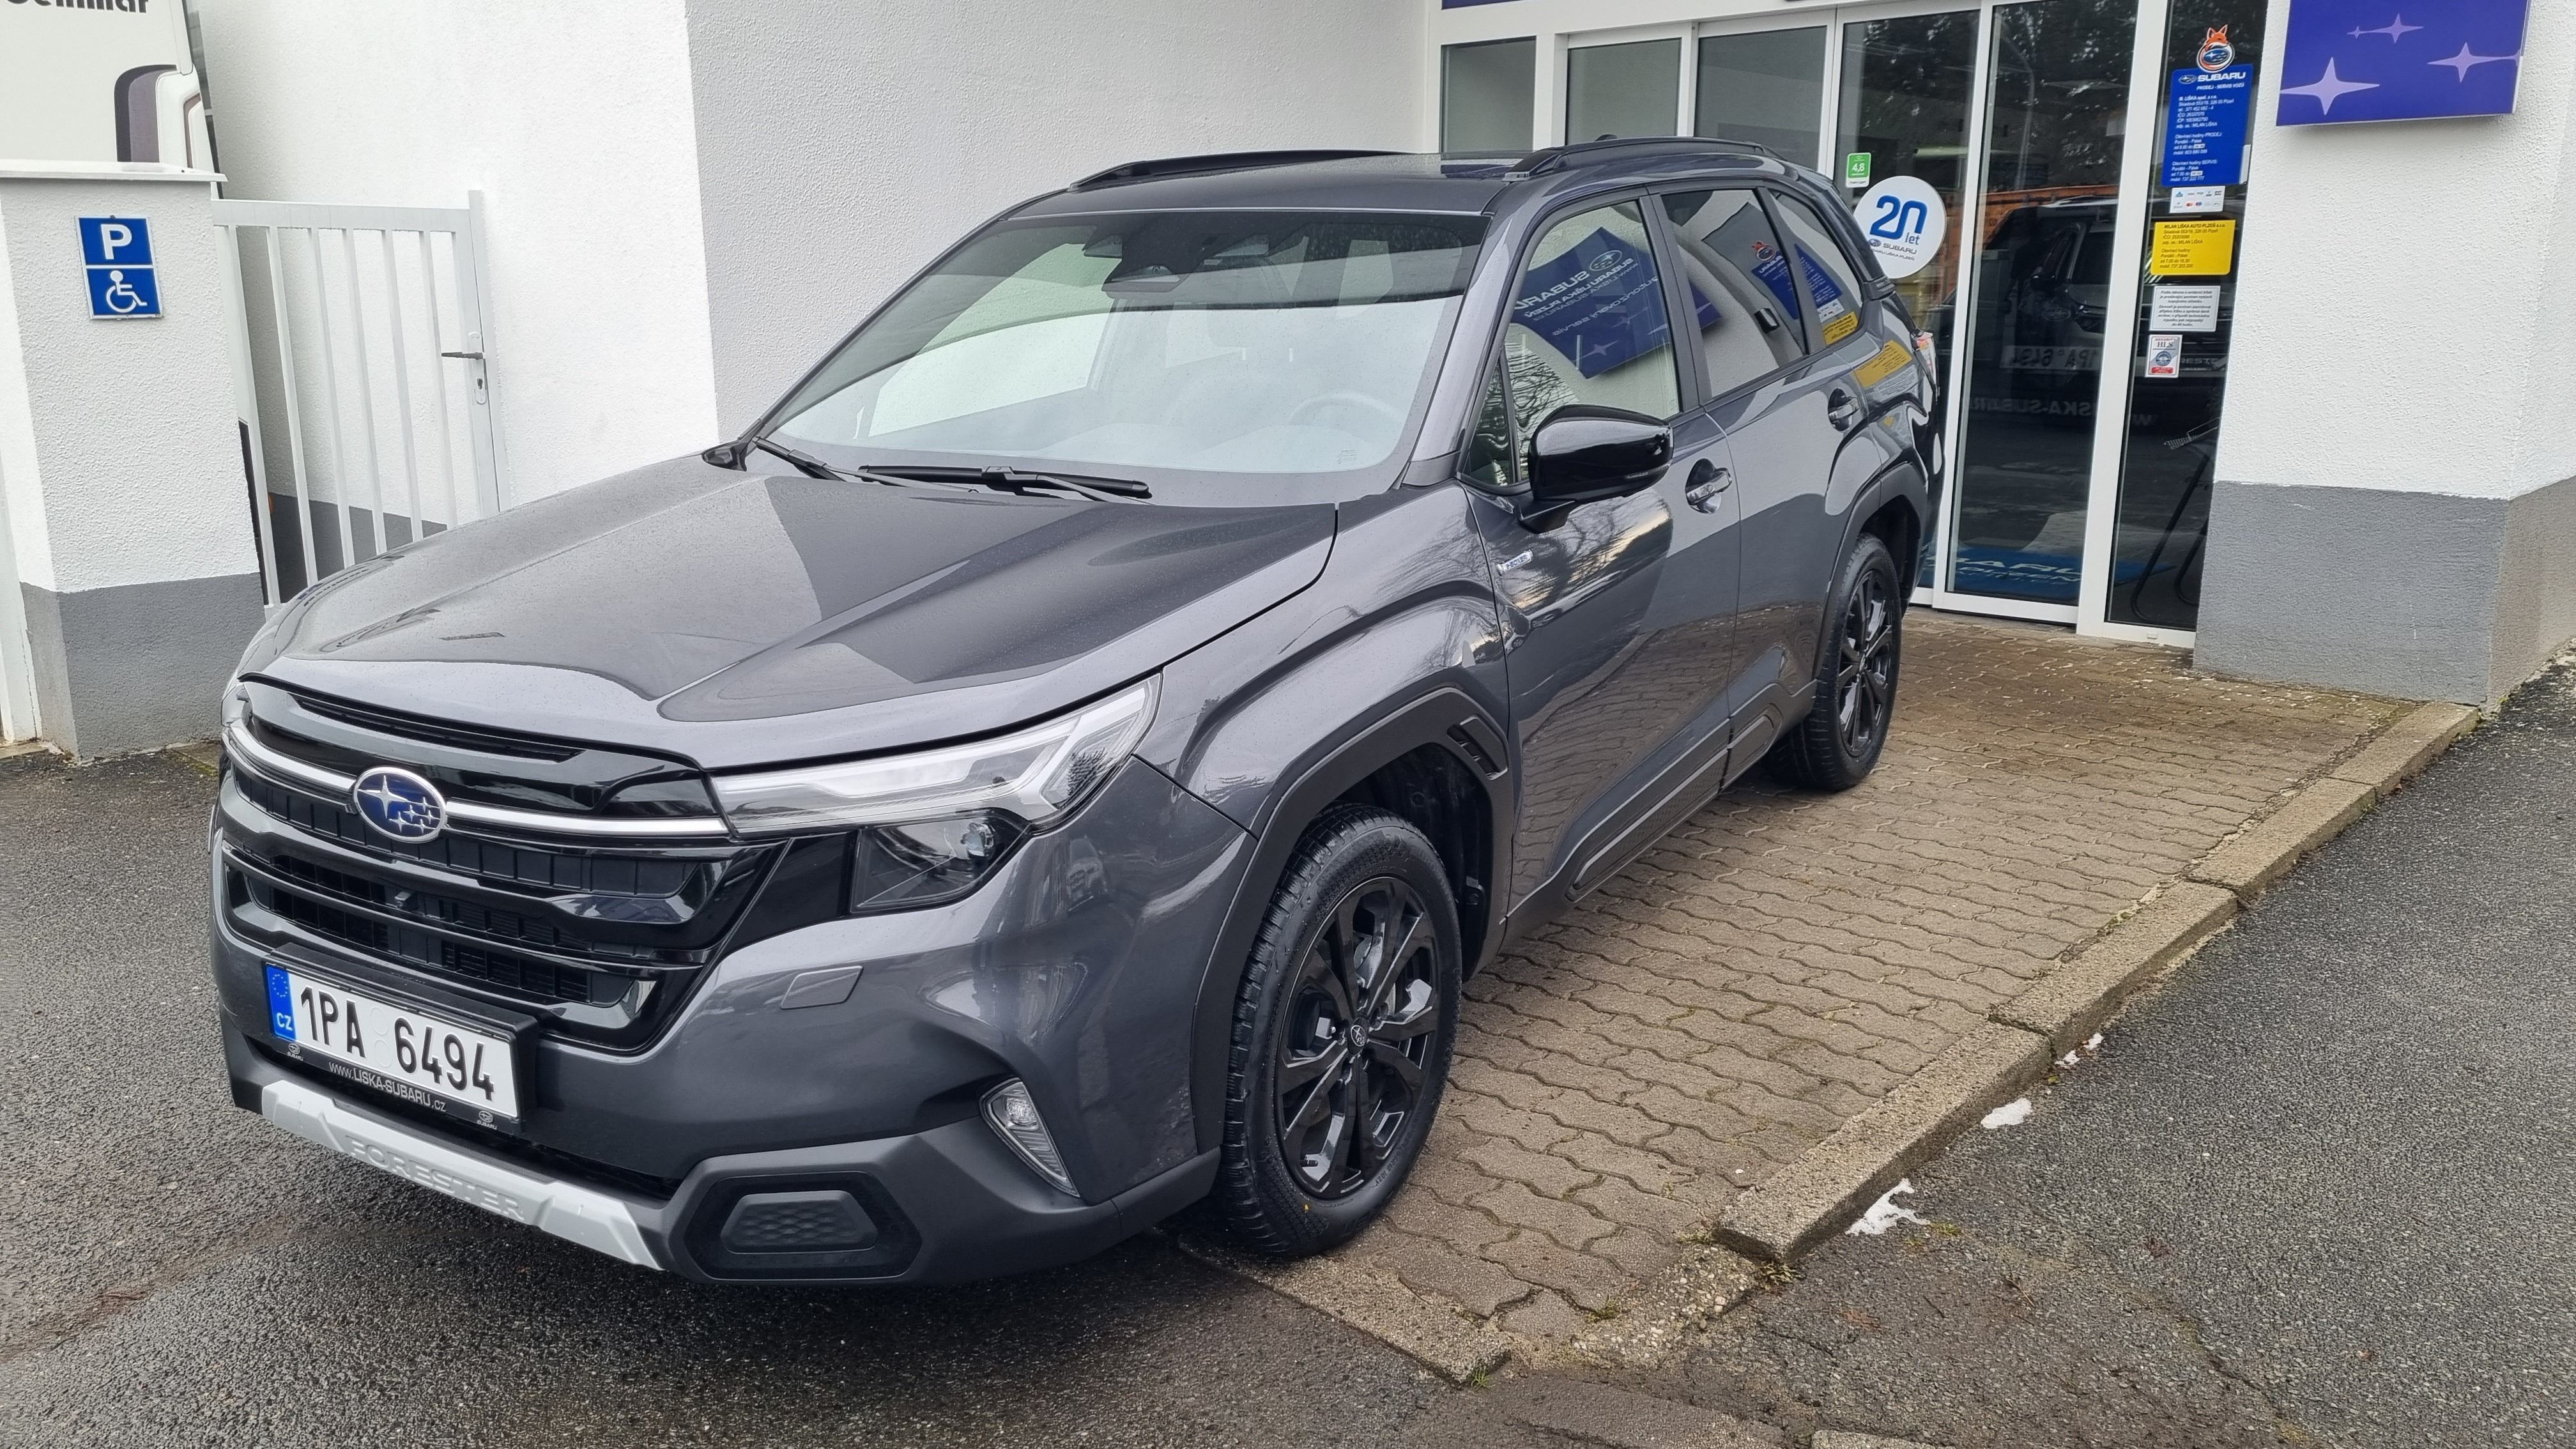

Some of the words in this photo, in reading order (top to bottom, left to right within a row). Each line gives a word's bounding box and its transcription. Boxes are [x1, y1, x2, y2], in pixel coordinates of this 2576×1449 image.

[2198, 72, 2246, 82] SUBARU
[1851, 163, 1865, 172] 4,8
[100, 224, 132, 261] P
[1905, 232, 1920, 245] let
[1883, 242, 1917, 254] SUBARU
[276, 1012, 295, 1031] CZ
[300, 987, 367, 1058] 1PA
[394, 1017, 495, 1101] 6494
[287, 1052, 304, 1062] SUBARU
[477, 1120, 497, 1130] SUBARU
[345, 1135, 525, 1221] FORESTER
